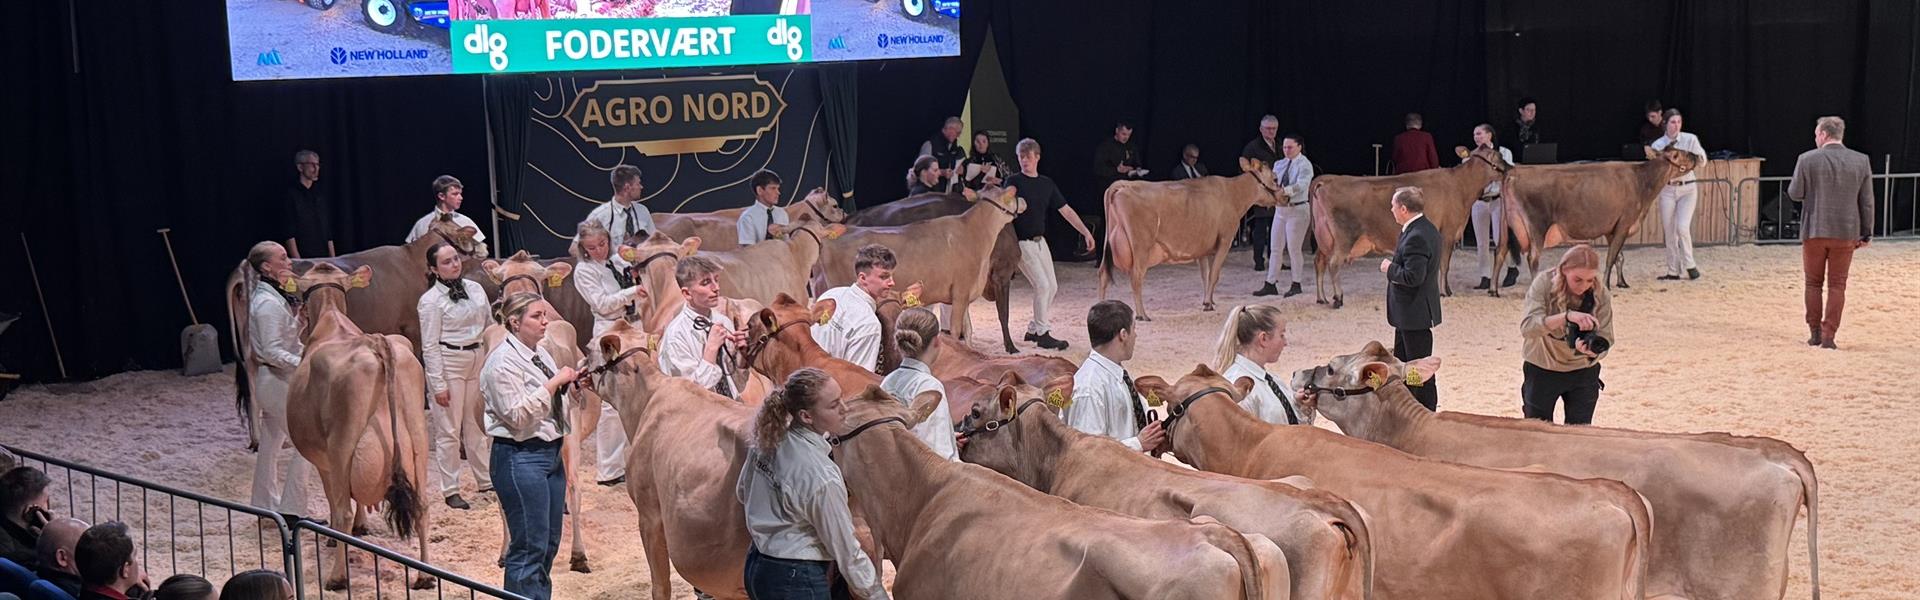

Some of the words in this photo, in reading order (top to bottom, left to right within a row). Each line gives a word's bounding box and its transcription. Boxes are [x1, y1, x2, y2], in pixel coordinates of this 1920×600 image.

[350, 50, 374, 60] NEW
[377, 49, 428, 60] HOLLAND
[464, 24, 508, 71] dlg
[546, 27, 736, 60] FODERVÆRT
[767, 18, 803, 61] dlg
[890, 35, 907, 45] NEW
[909, 35, 943, 44] HOLLAND
[582, 95, 673, 128] AGRO
[683, 91, 771, 122] NORD
